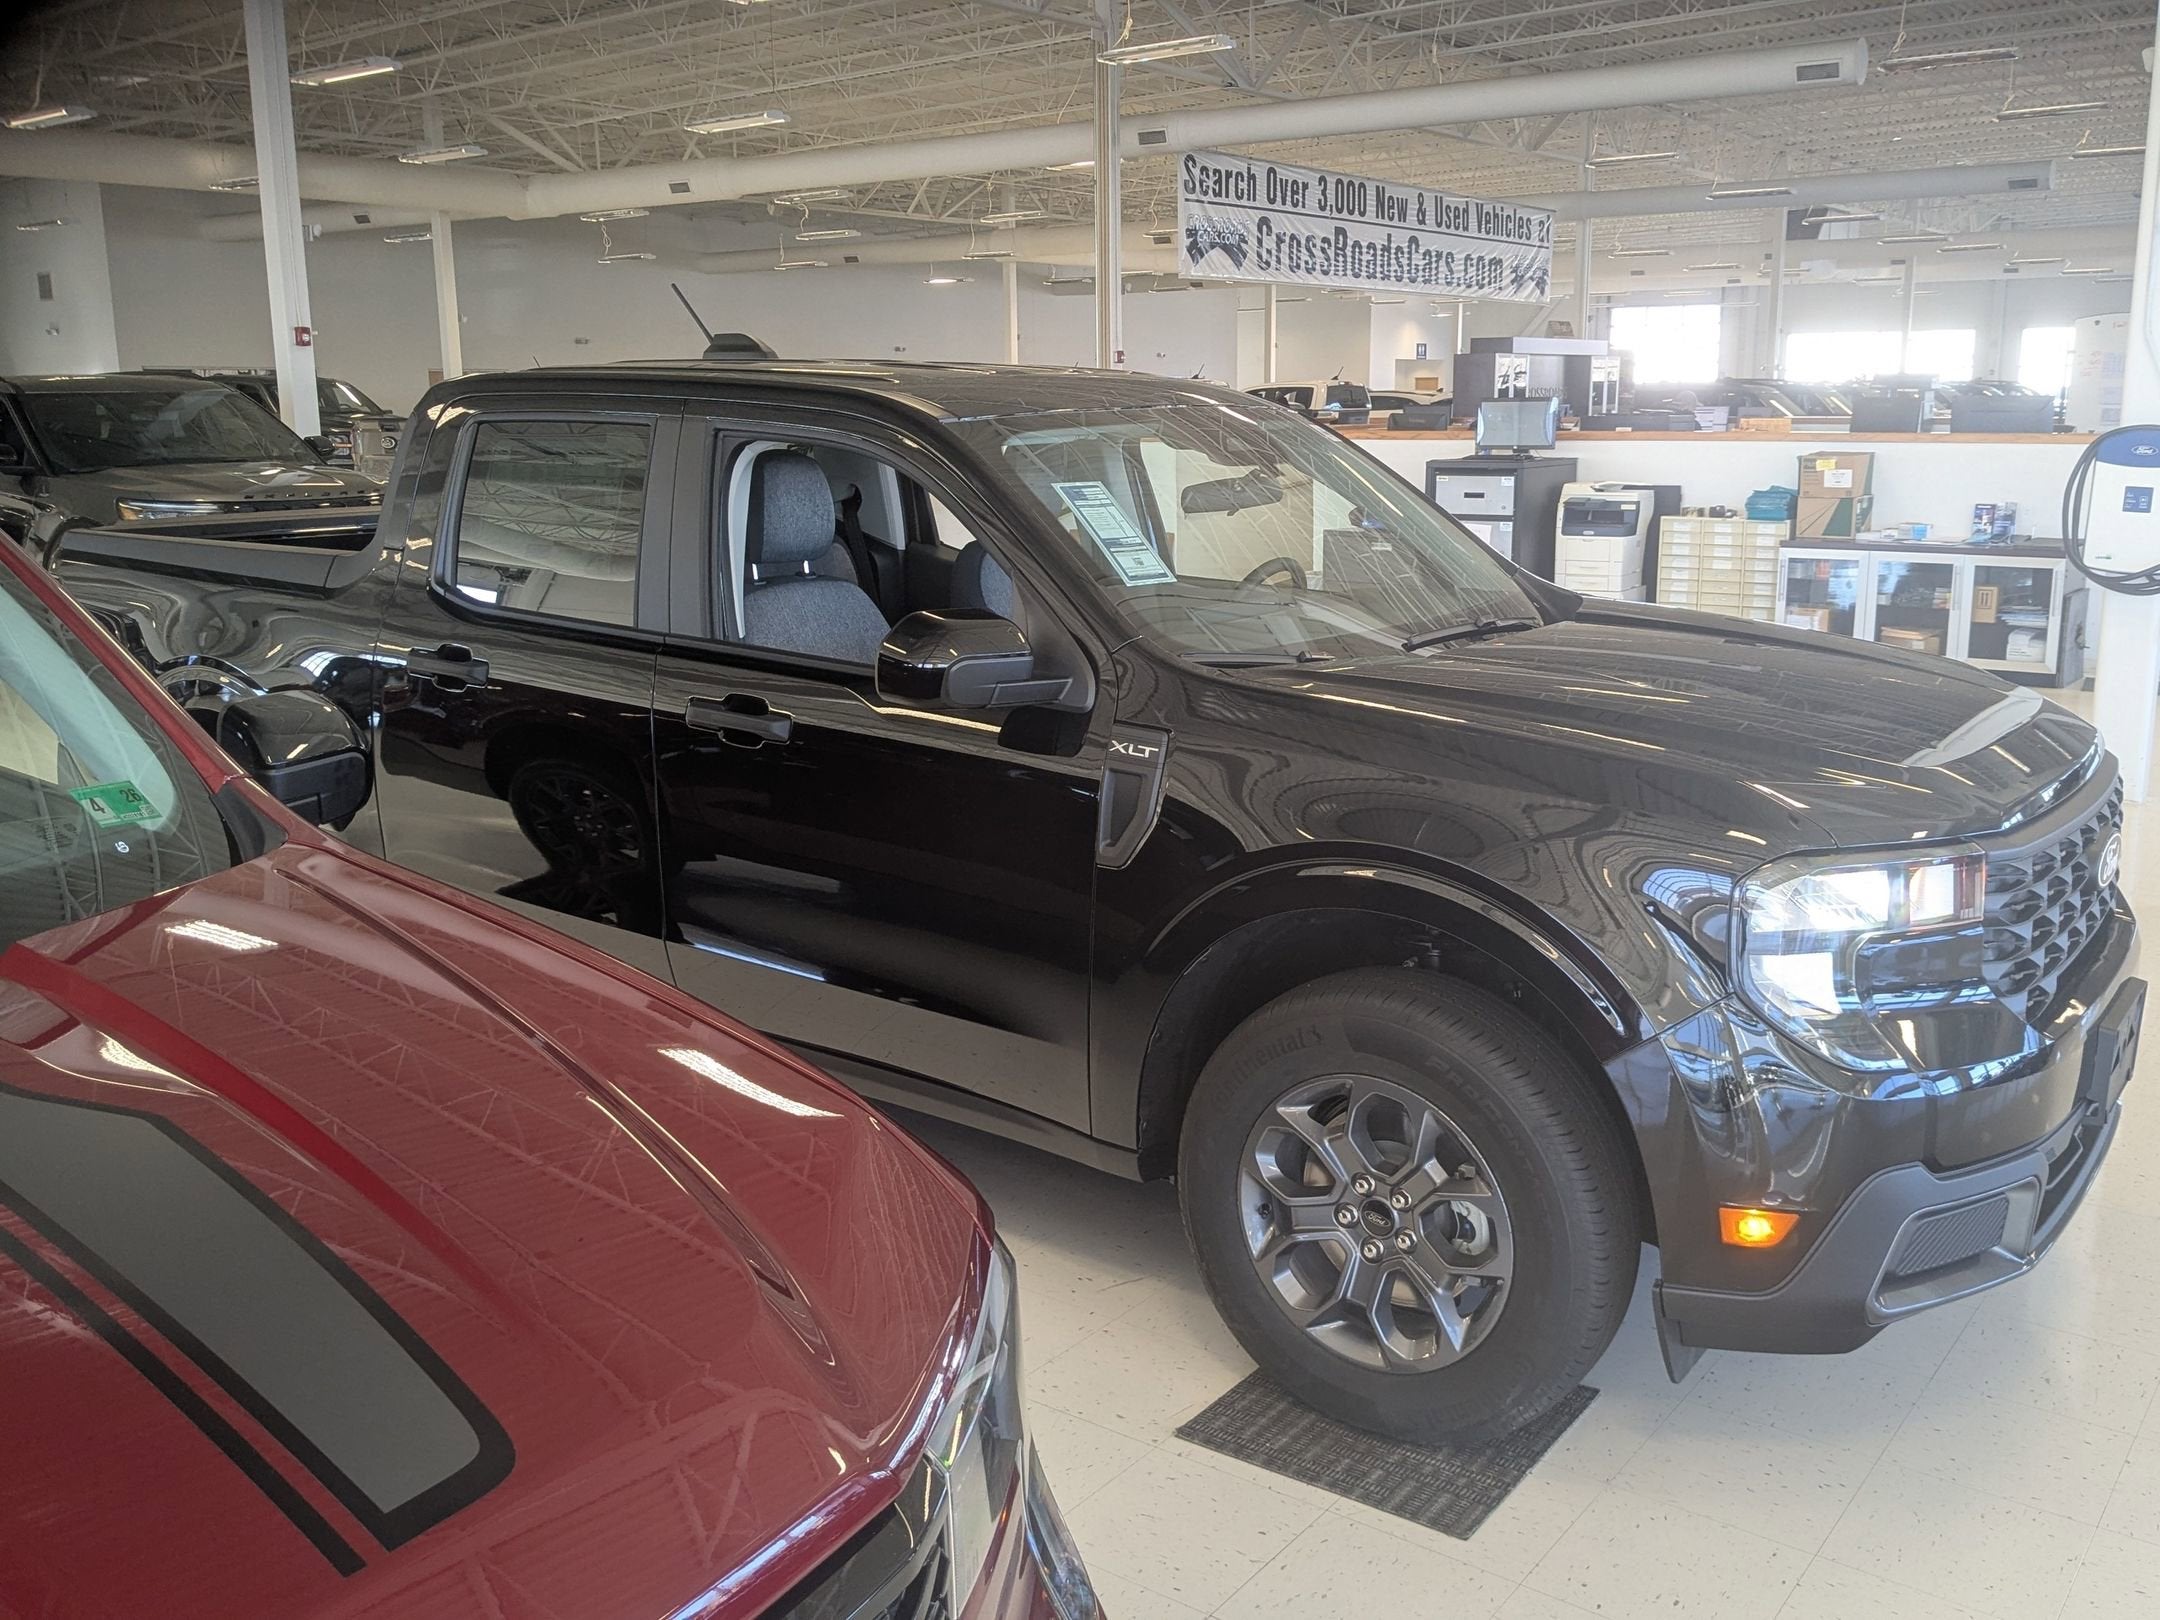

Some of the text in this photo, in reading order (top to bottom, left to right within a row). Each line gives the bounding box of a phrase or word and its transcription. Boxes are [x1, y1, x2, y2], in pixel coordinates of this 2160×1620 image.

[1183, 153, 1257, 202] Search
[1266, 166, 1309, 209] Over
[1318, 174, 1367, 217] 3,000
[1375, 184, 1408, 223] New
[1416, 191, 1427, 226] &
[1434, 195, 1469, 232] Used
[1475, 202, 1532, 241] Vehicles
[1256, 215, 1504, 291] CrossRoadsCars.com
[1109, 740, 1159, 758] XLT
[119, 788, 142, 803] 26
[88, 797, 106, 814] 4
